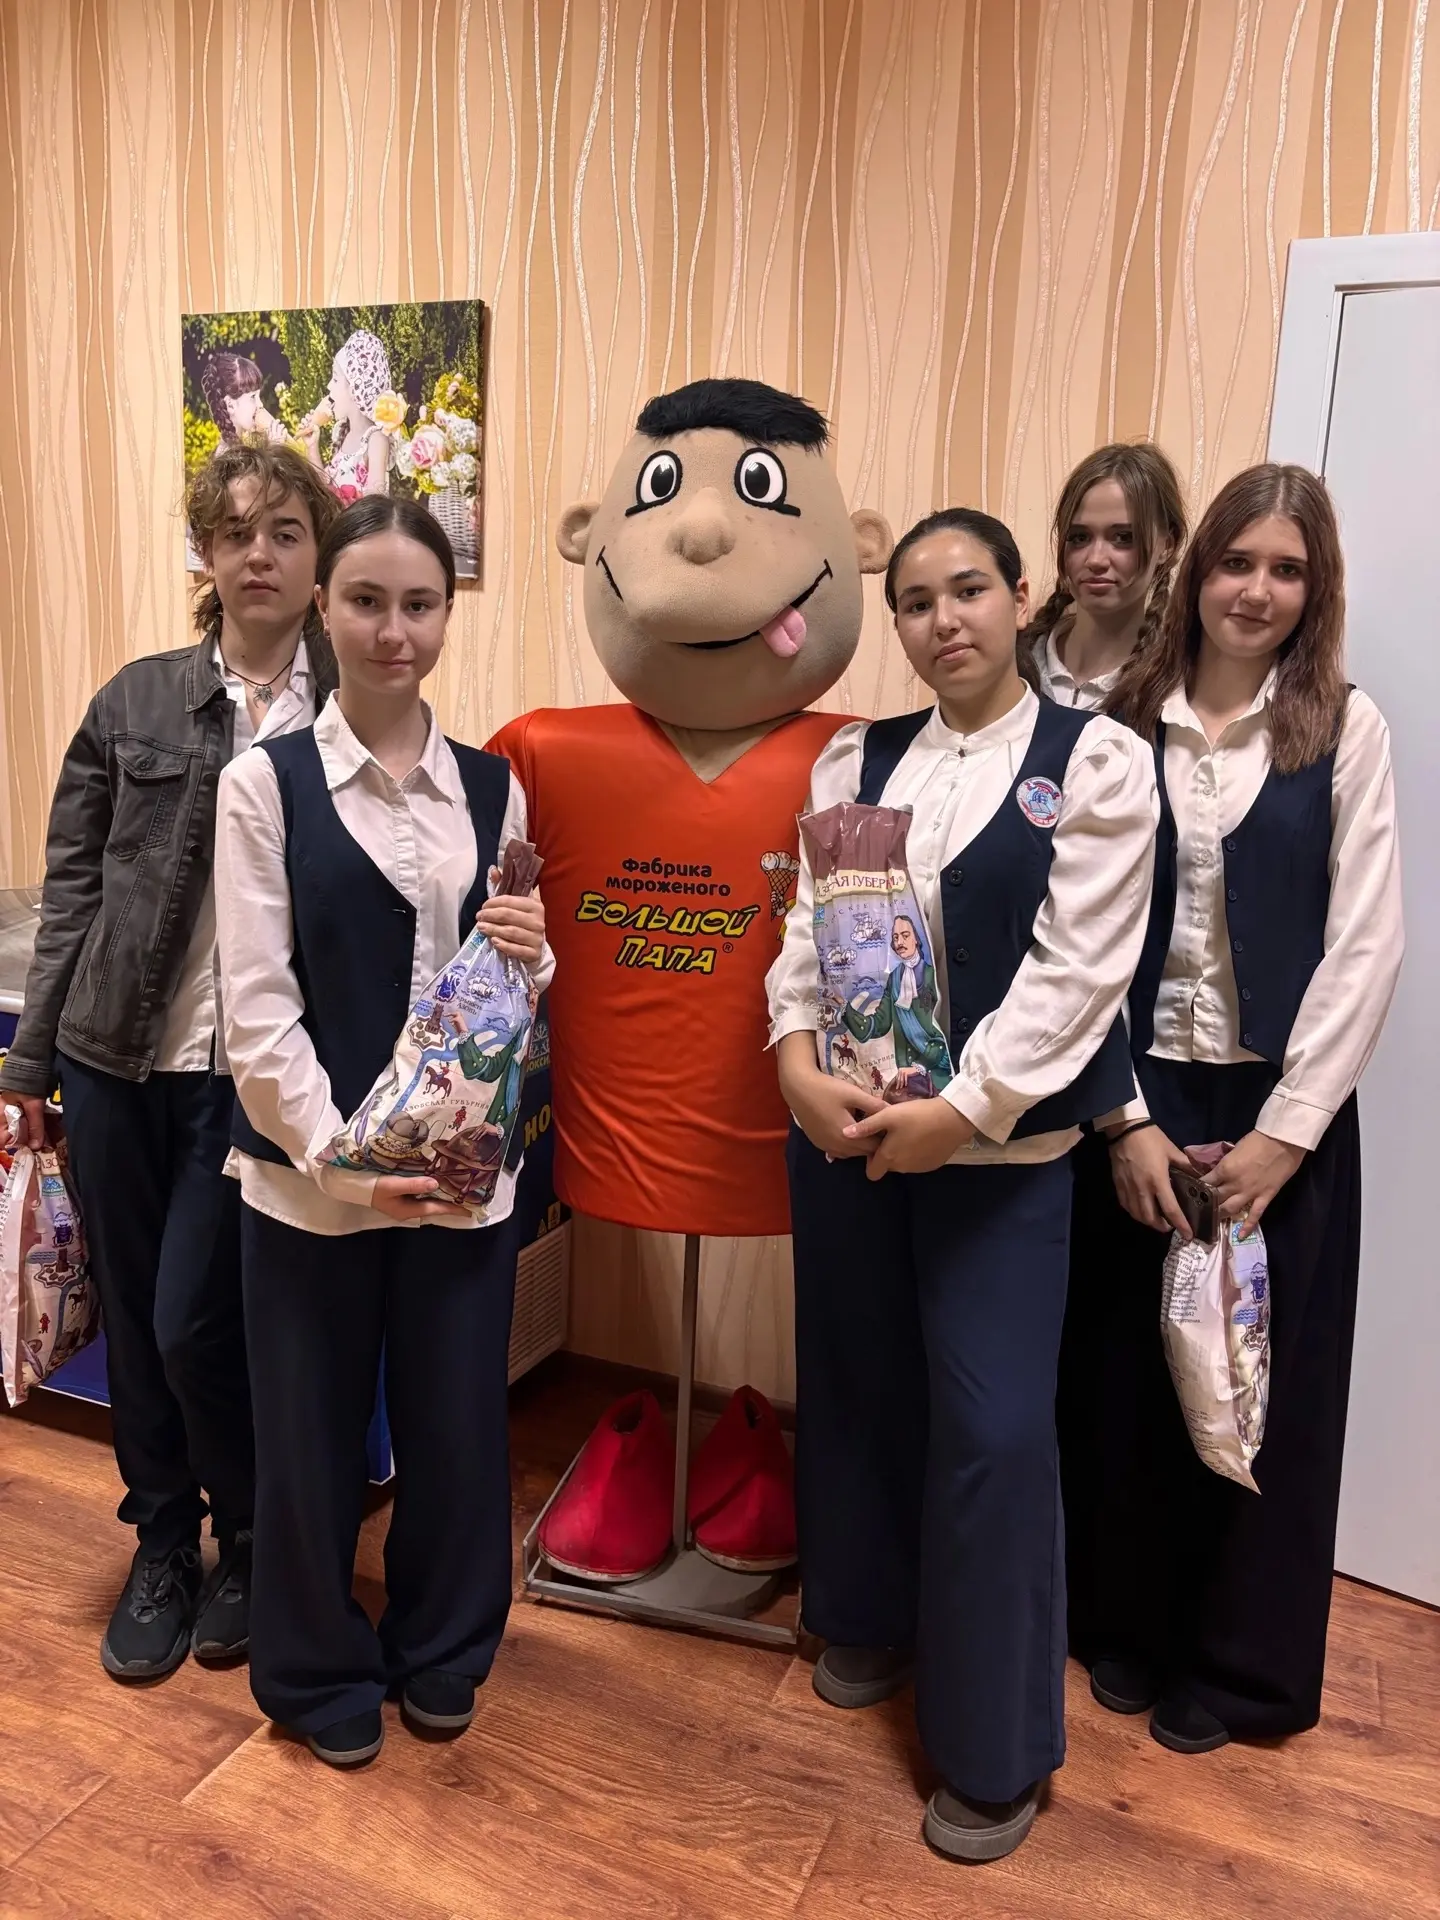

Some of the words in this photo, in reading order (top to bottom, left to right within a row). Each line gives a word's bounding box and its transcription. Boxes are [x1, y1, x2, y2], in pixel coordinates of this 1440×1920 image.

[622, 857, 712, 878] Фабрика
[606, 876, 731, 896] мороженого
[615, 935, 717, 975] ПАПА
